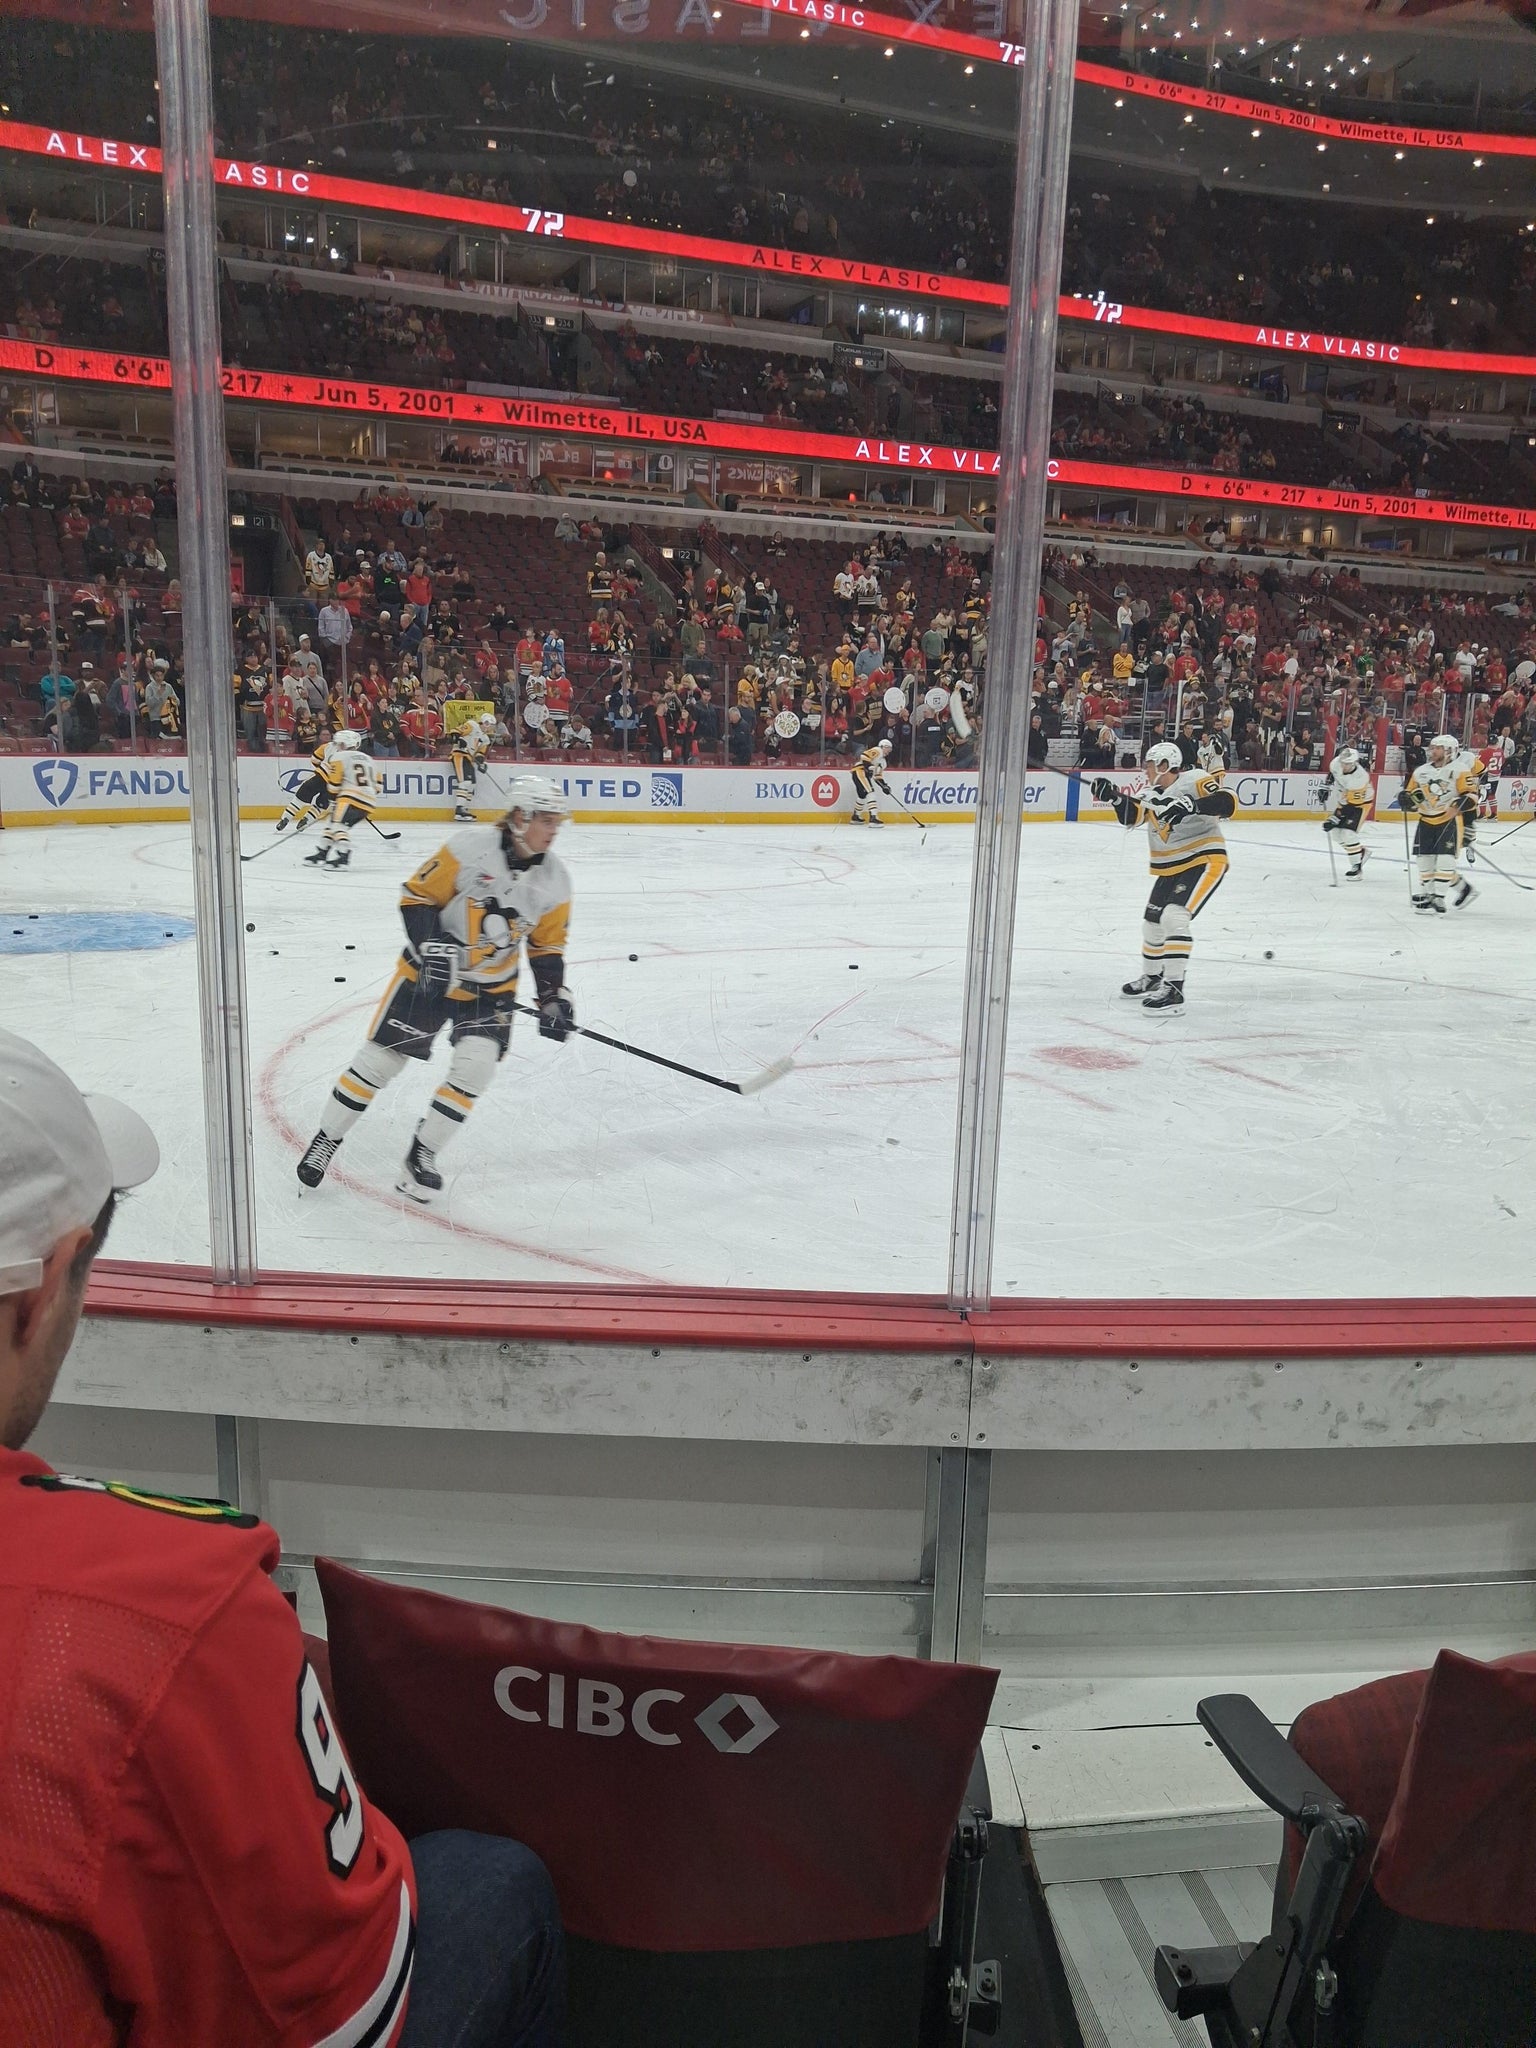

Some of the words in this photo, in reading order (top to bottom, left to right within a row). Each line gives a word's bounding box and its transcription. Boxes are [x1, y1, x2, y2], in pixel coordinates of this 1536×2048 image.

[1000, 42, 1026, 64] 72
[1125, 76, 1134, 88] D
[1206, 95, 1226, 109] 217
[1249, 103, 1270, 119] Jun
[1275, 112, 1285, 125] 5,
[1289, 113, 1316, 129] 2001
[1340, 123, 1407, 143] Wilmette,
[1413, 132, 1430, 146] IL,
[1436, 133, 1463, 147] USA
[47, 132, 147, 168] ALEX
[225, 163, 310, 192] ASIC
[522, 207, 564, 238] 72
[752, 249, 823, 274] ALEX
[841, 261, 942, 292] VLASIC
[1093, 301, 1122, 324] 72
[35, 350, 54, 369] D
[1256, 328, 1310, 349] ALEX
[1324, 337, 1400, 361] VLASIC
[222, 372, 262, 394] 217
[314, 382, 357, 405] Jun
[367, 388, 388, 411] 5,
[397, 391, 455, 414] 2001
[503, 402, 617, 434] Wilmette,
[627, 417, 654, 438] IL,
[664, 420, 708, 442] USA
[856, 440, 933, 466] ALEX
[952, 451, 1060, 478] VLAC
[1181, 477, 1191, 490] D
[1281, 488, 1305, 503] 217
[1334, 494, 1359, 511] Jun
[1366, 497, 1377, 514] 5,
[1383, 499, 1416, 515] 2001
[1445, 505, 1512, 526] Wilmette,
[1518, 513, 1534, 528] IL,
[88, 771, 190, 796] FANDU
[562, 779, 642, 797] ITED
[755, 782, 804, 799] BMO
[1236, 777, 1294, 807] GTL
[494, 1665, 686, 1746] CIBC
[298, 1658, 366, 1879] 9
